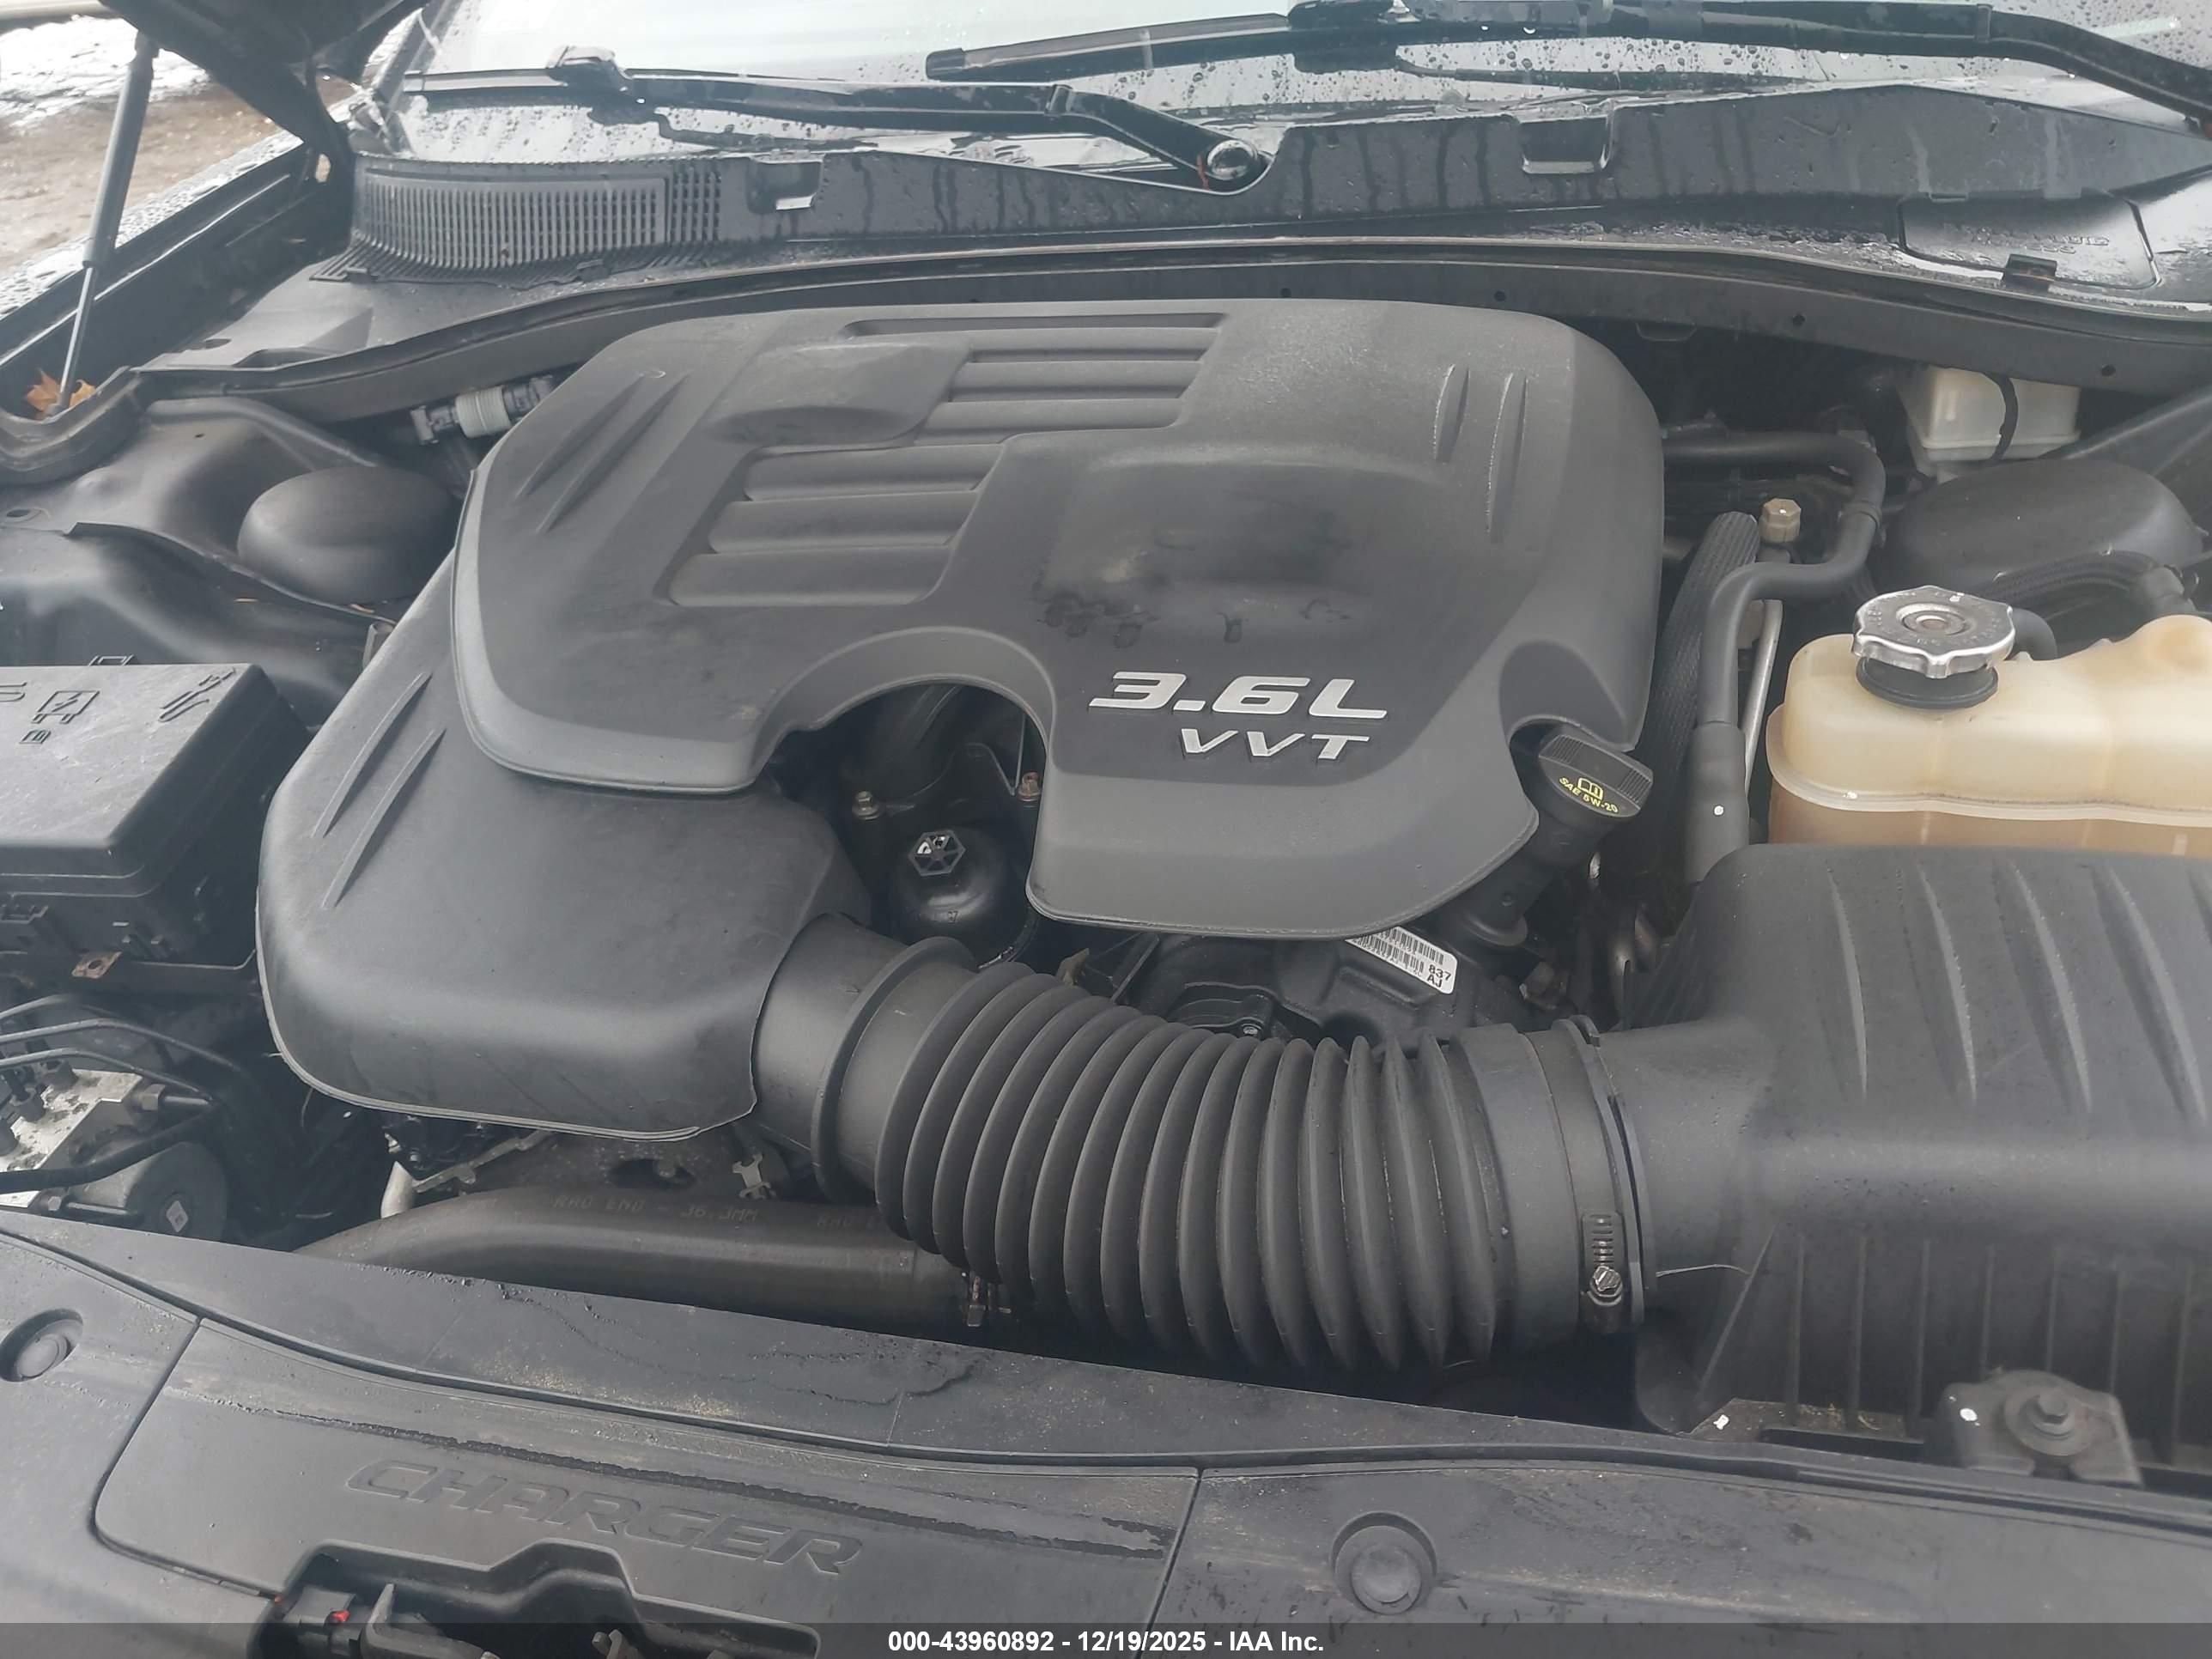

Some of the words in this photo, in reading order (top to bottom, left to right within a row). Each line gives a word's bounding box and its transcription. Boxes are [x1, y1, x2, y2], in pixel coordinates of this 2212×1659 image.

[1088, 671, 1389, 720] 3.6L
[1180, 728, 1370, 760] VVT
[1559, 776, 1582, 796] SAE
[1583, 793, 1619, 813] 5W-20
[1426, 974, 1443, 988] AJ
[1428, 963, 1452, 981] 837
[345, 1459, 863, 1576] CHARGER
